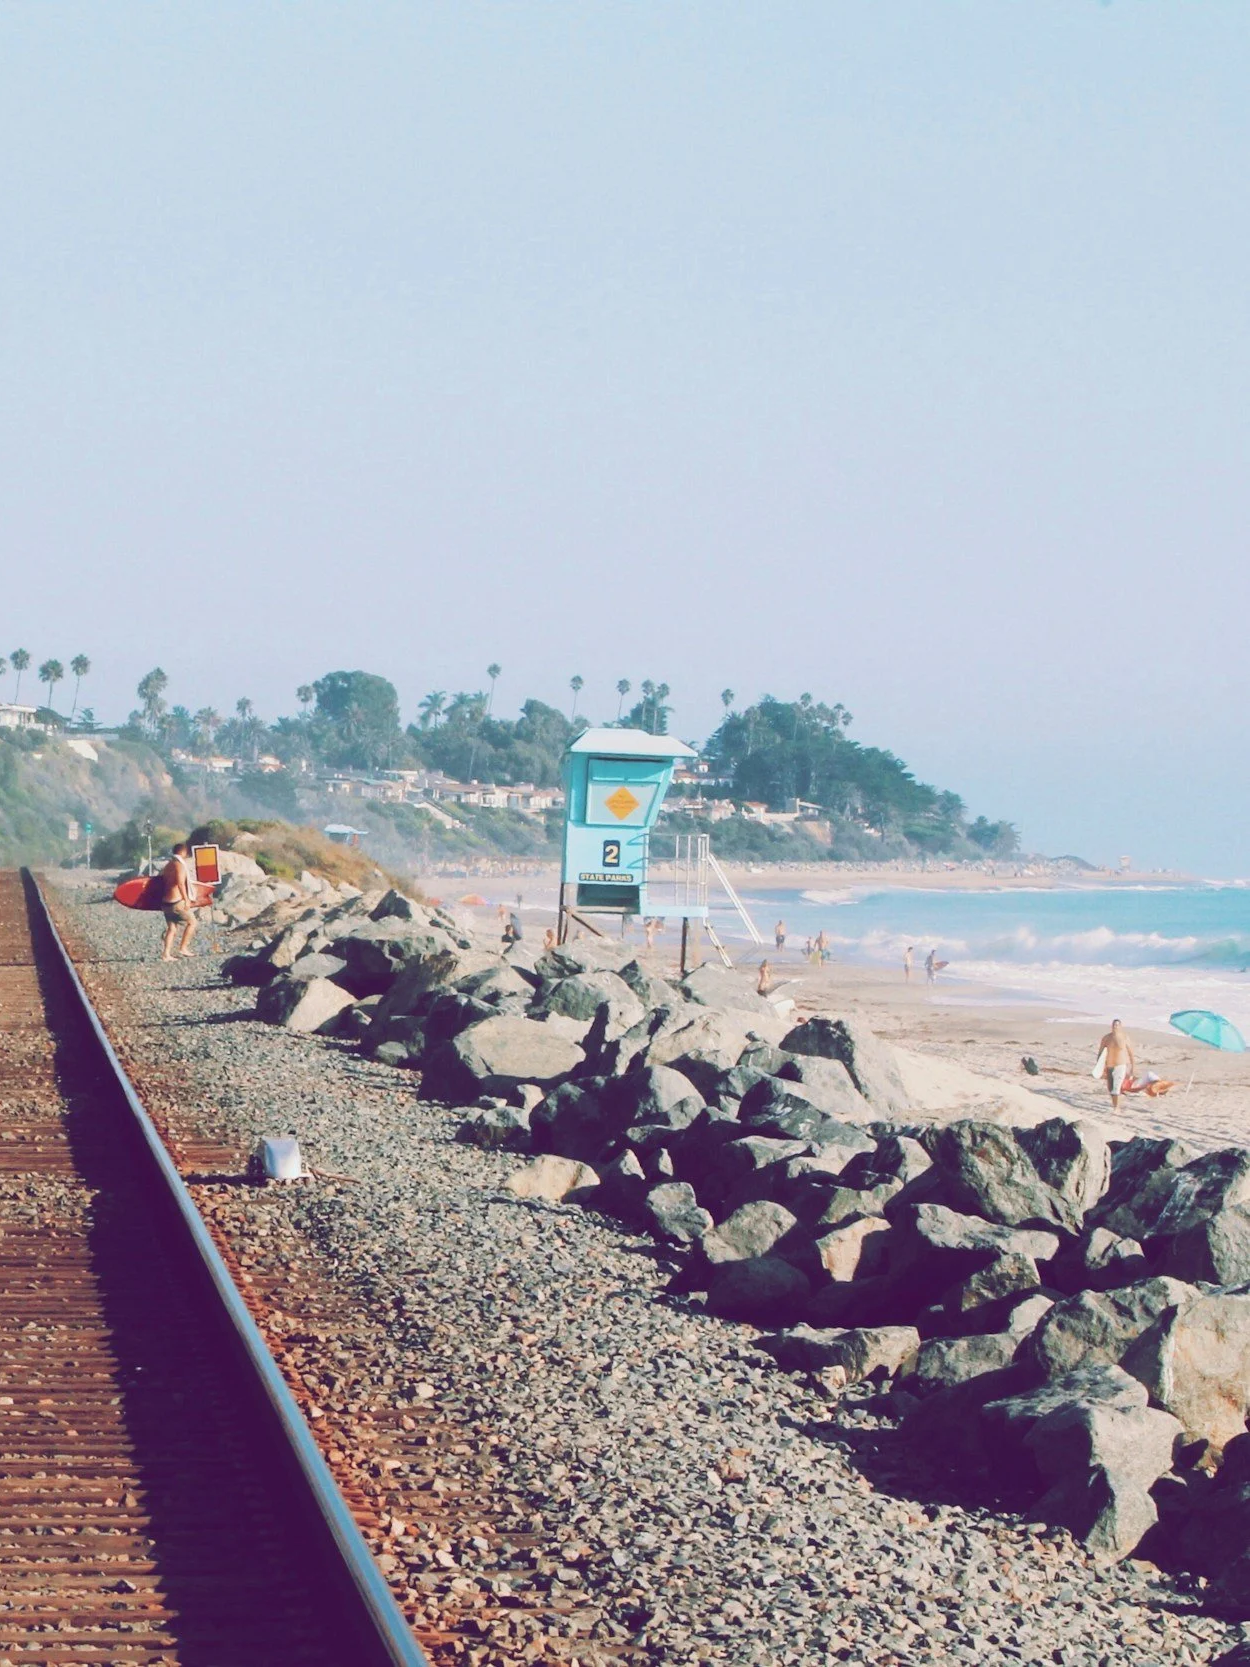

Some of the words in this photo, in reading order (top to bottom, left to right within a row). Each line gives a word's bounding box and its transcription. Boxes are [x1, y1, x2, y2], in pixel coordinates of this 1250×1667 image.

[604, 845, 619, 864] 2
[580, 873, 604, 881] STATE
[605, 874, 631, 882] PARKS
